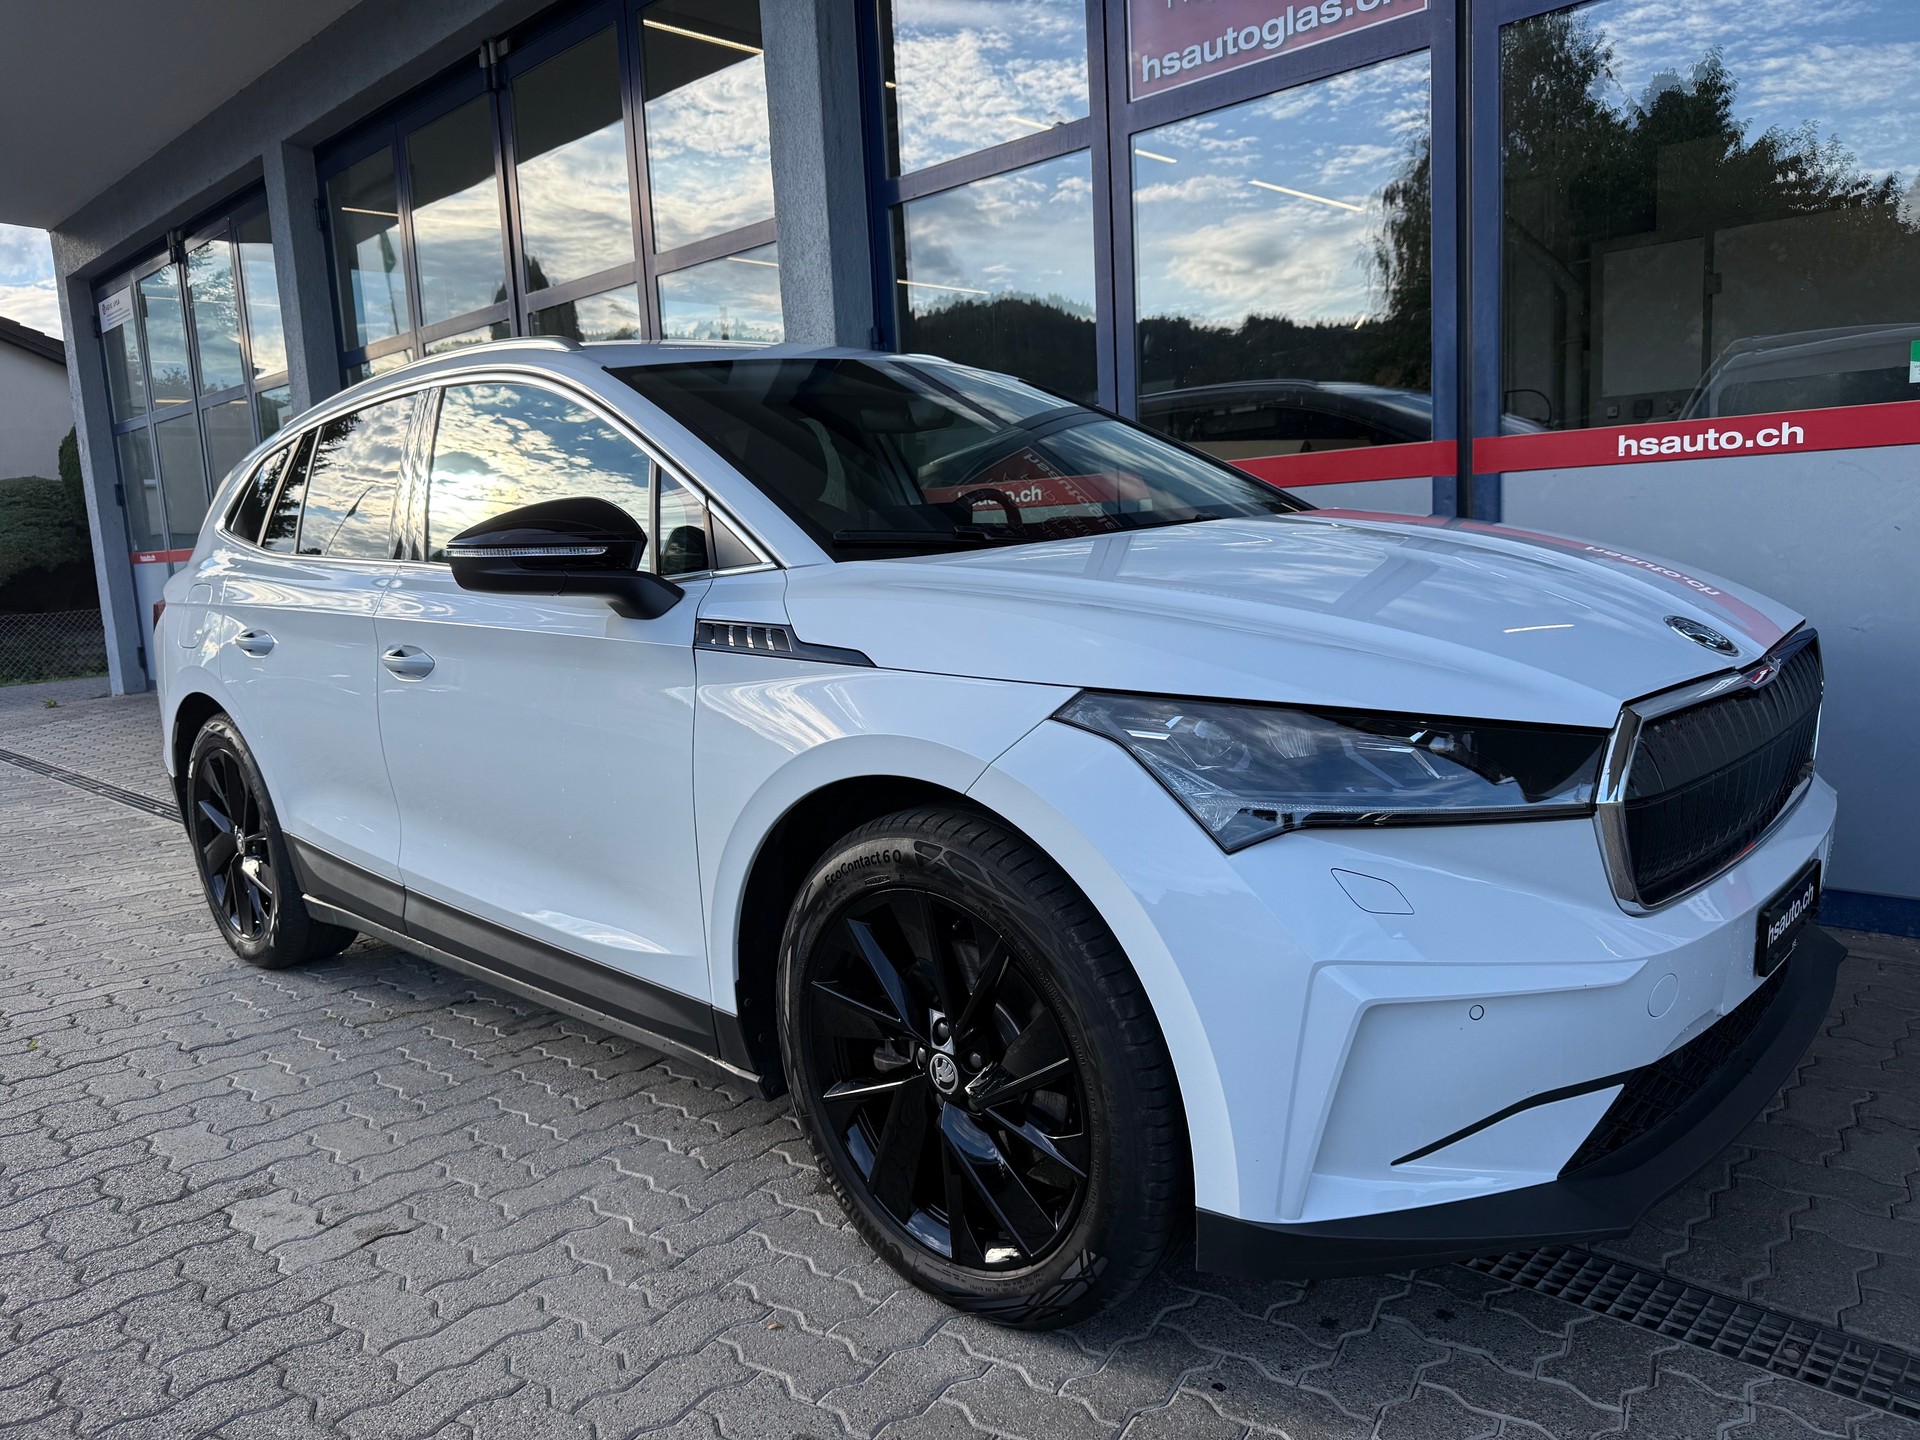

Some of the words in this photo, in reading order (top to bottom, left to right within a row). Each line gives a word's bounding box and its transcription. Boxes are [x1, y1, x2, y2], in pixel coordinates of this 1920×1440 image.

[1141, 0, 1392, 82] hsautoglas.c
[1617, 421, 1804, 457] hsauto.ch
[824, 851, 882, 888] EcoContact
[882, 849, 891, 864] 6
[892, 848, 903, 865] Q
[1766, 882, 1815, 949] hsauto.ch
